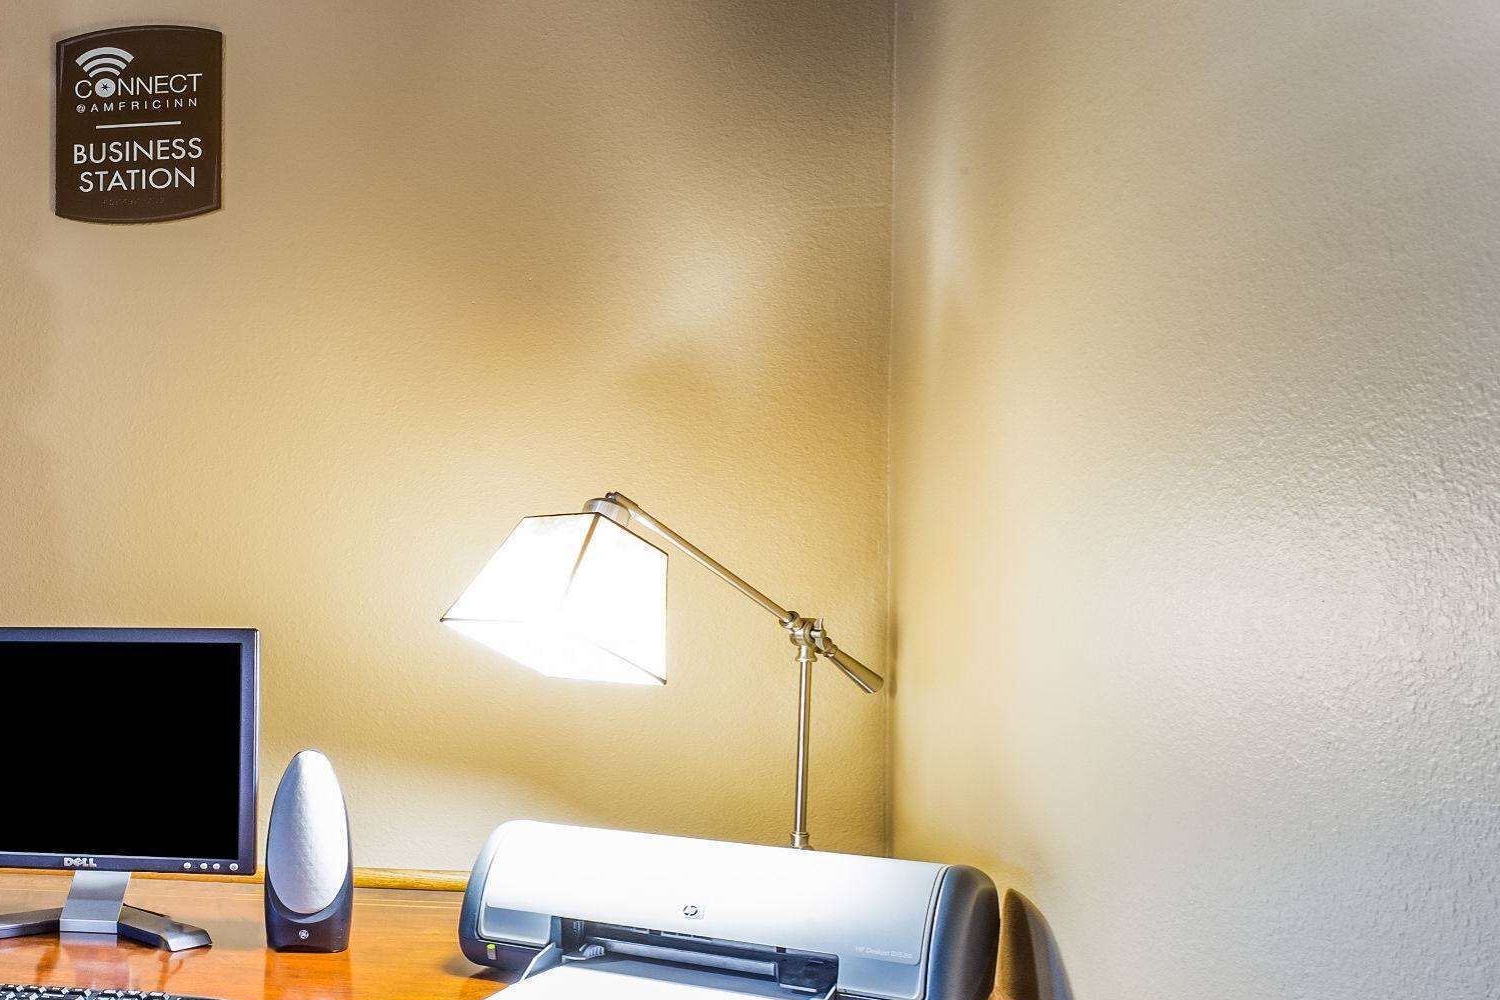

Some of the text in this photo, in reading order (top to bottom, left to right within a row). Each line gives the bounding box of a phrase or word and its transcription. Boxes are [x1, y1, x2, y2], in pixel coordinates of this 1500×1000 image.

[75, 73, 202, 98] CONNECT
[73, 137, 203, 165] BUSINESS
[79, 166, 196, 193] STATION
[64, 857, 97, 867] DELL
